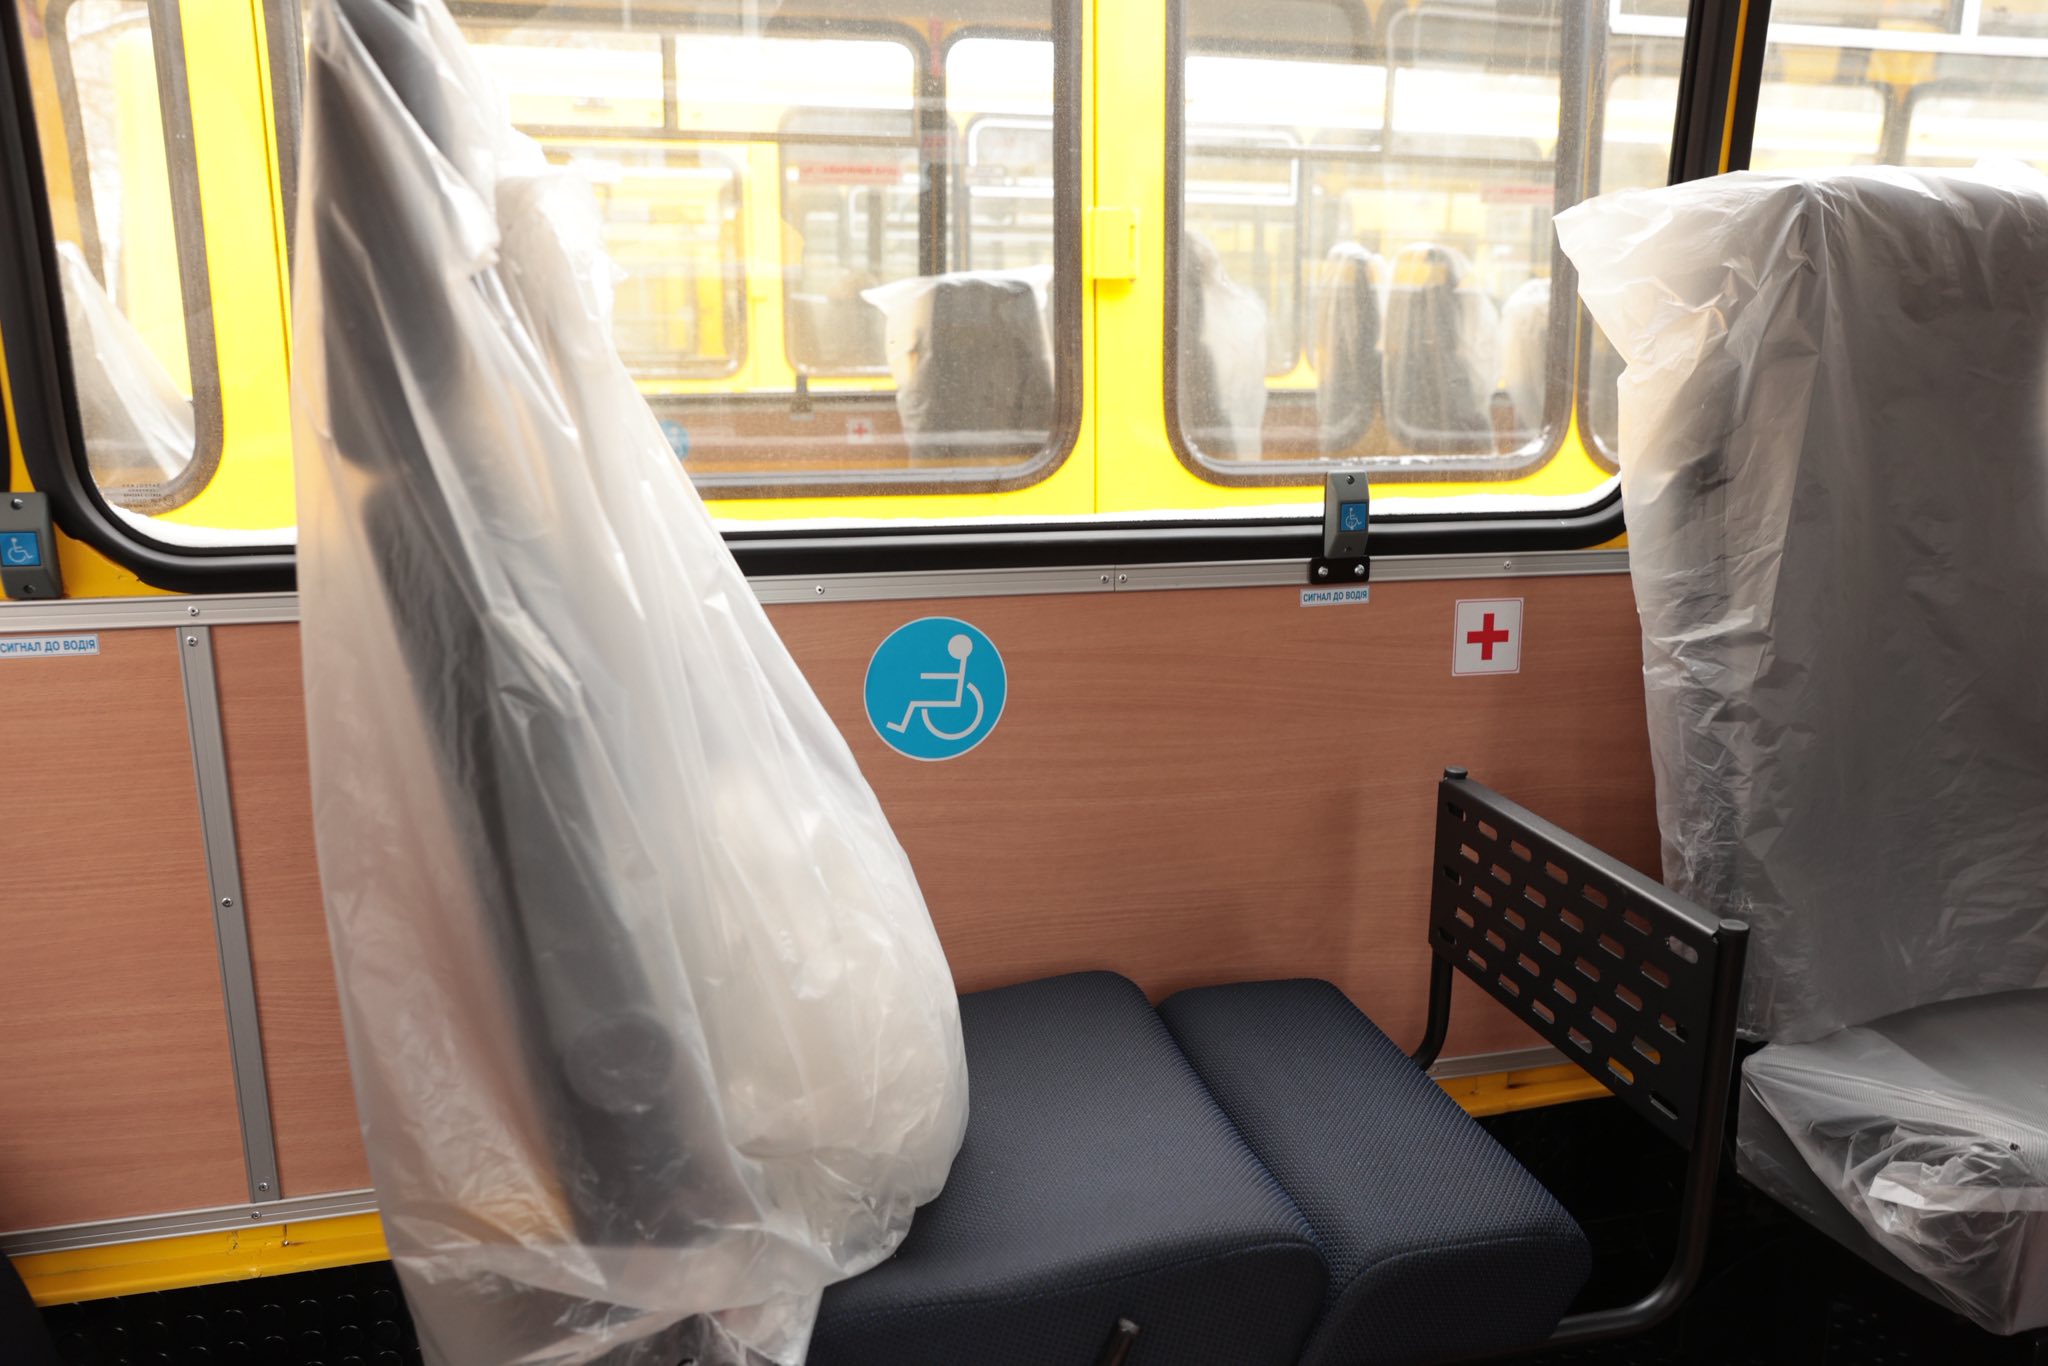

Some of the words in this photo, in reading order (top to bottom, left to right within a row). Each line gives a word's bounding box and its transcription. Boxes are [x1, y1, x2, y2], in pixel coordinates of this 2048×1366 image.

[1303, 592, 1331, 602] СИГНАЛ
[1332, 591, 1344, 602] ДО
[1345, 590, 1367, 600] ВОДІЯ
[0, 641, 41, 653] СИГНАЛ
[45, 641, 60, 653] ДО
[63, 639, 96, 651] ВОДІЯ
